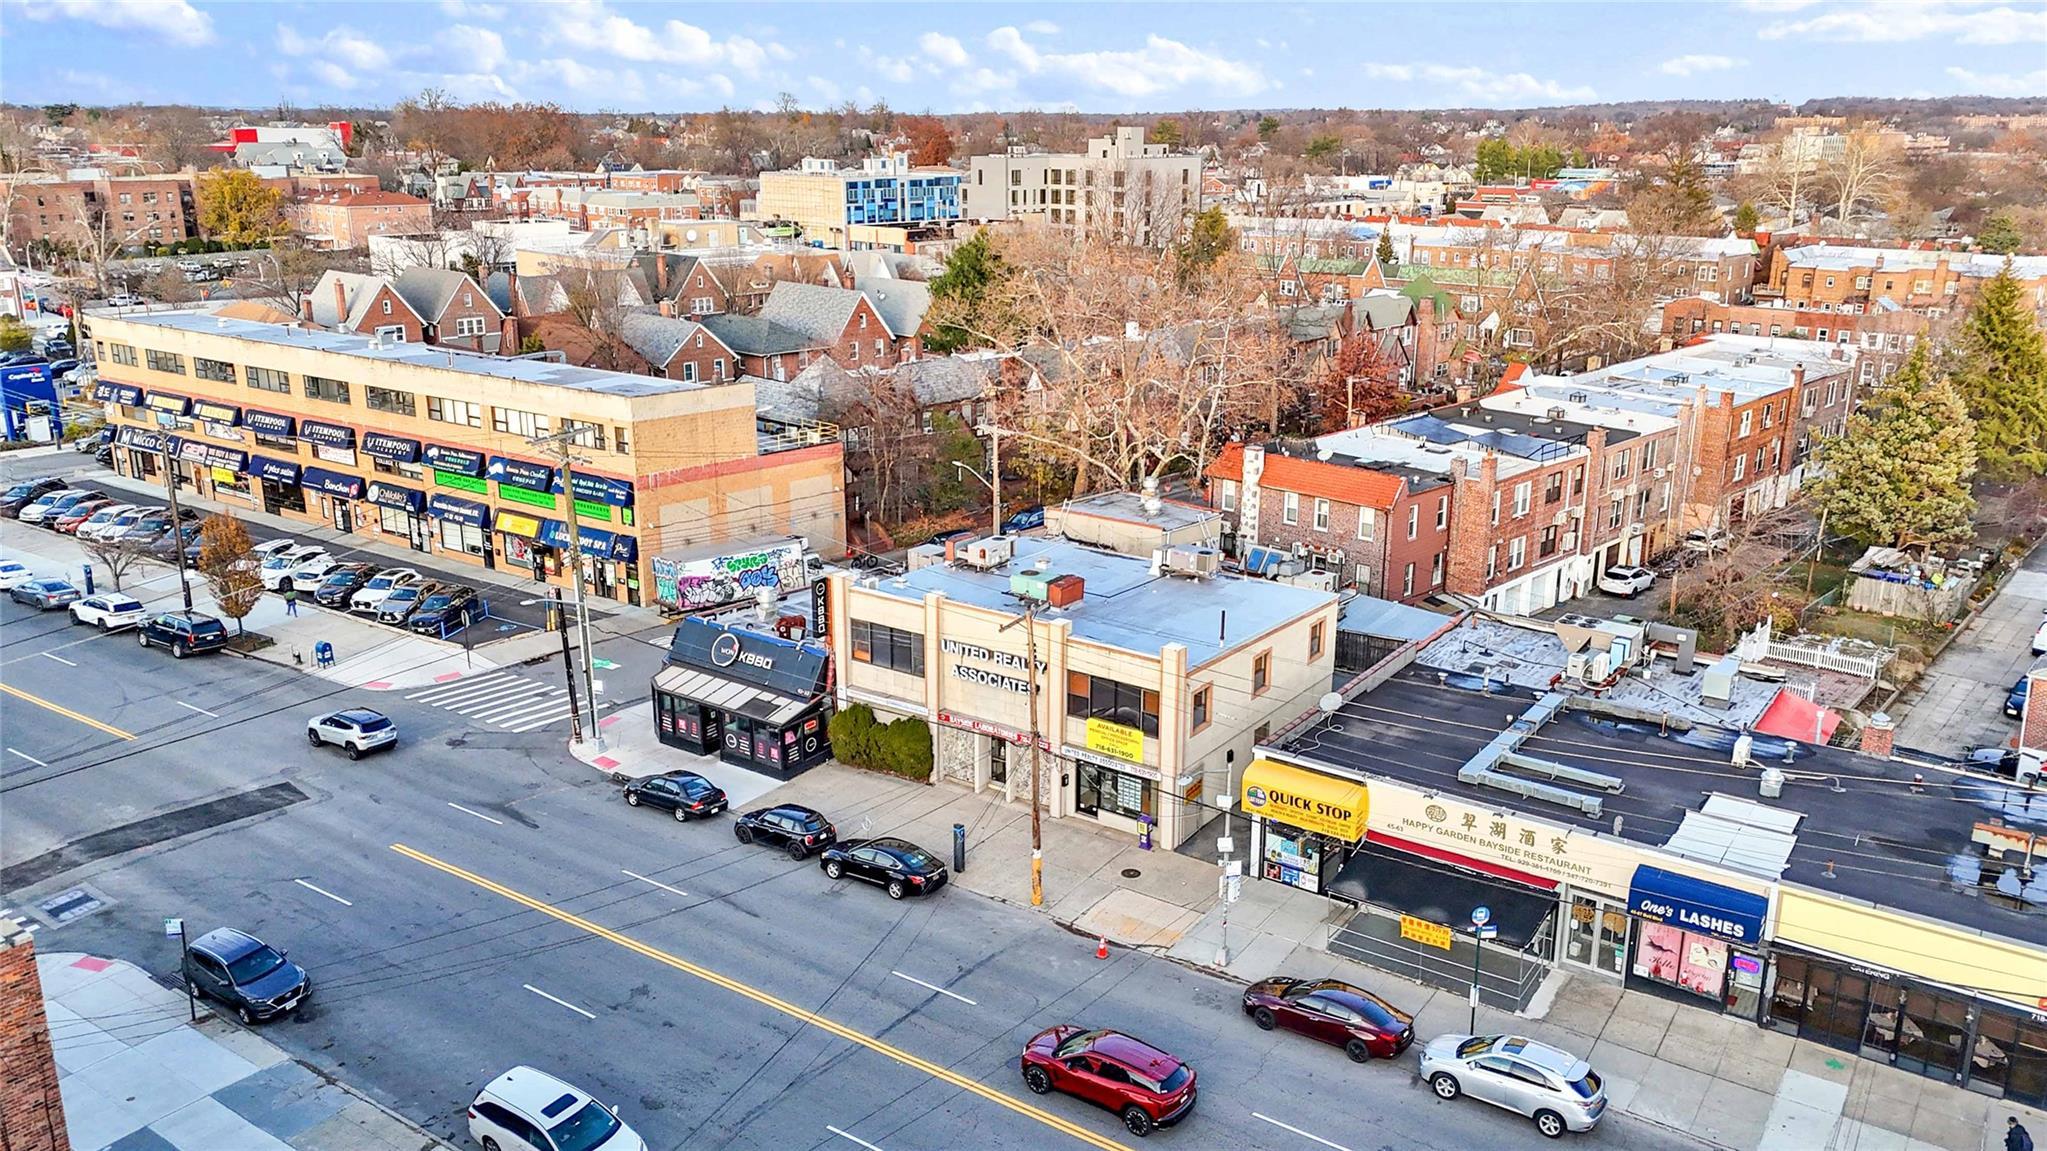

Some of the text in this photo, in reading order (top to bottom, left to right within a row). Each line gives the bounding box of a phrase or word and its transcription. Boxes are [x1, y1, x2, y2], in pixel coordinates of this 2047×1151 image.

[132, 435, 155, 448] MICCO
[156, 441, 174, 453] CFE
[312, 425, 346, 439] ITEMPOOL
[375, 438, 411, 452] ITEMPOOL
[555, 531, 572, 543] LUCK
[593, 540, 607, 551] SPA
[941, 639, 1047, 675] UNITED REALY
[1097, 723, 1132, 737] AVAILABLE
[1269, 790, 1312, 811] QUICK
[1317, 803, 1352, 821] STOP
[1461, 812, 1568, 855] 翠湖酒家
[1402, 818, 1592, 875] HAPPY GARDEN BAYSIDE RESTAURANT
[1640, 899, 1744, 937] One's LASHES
